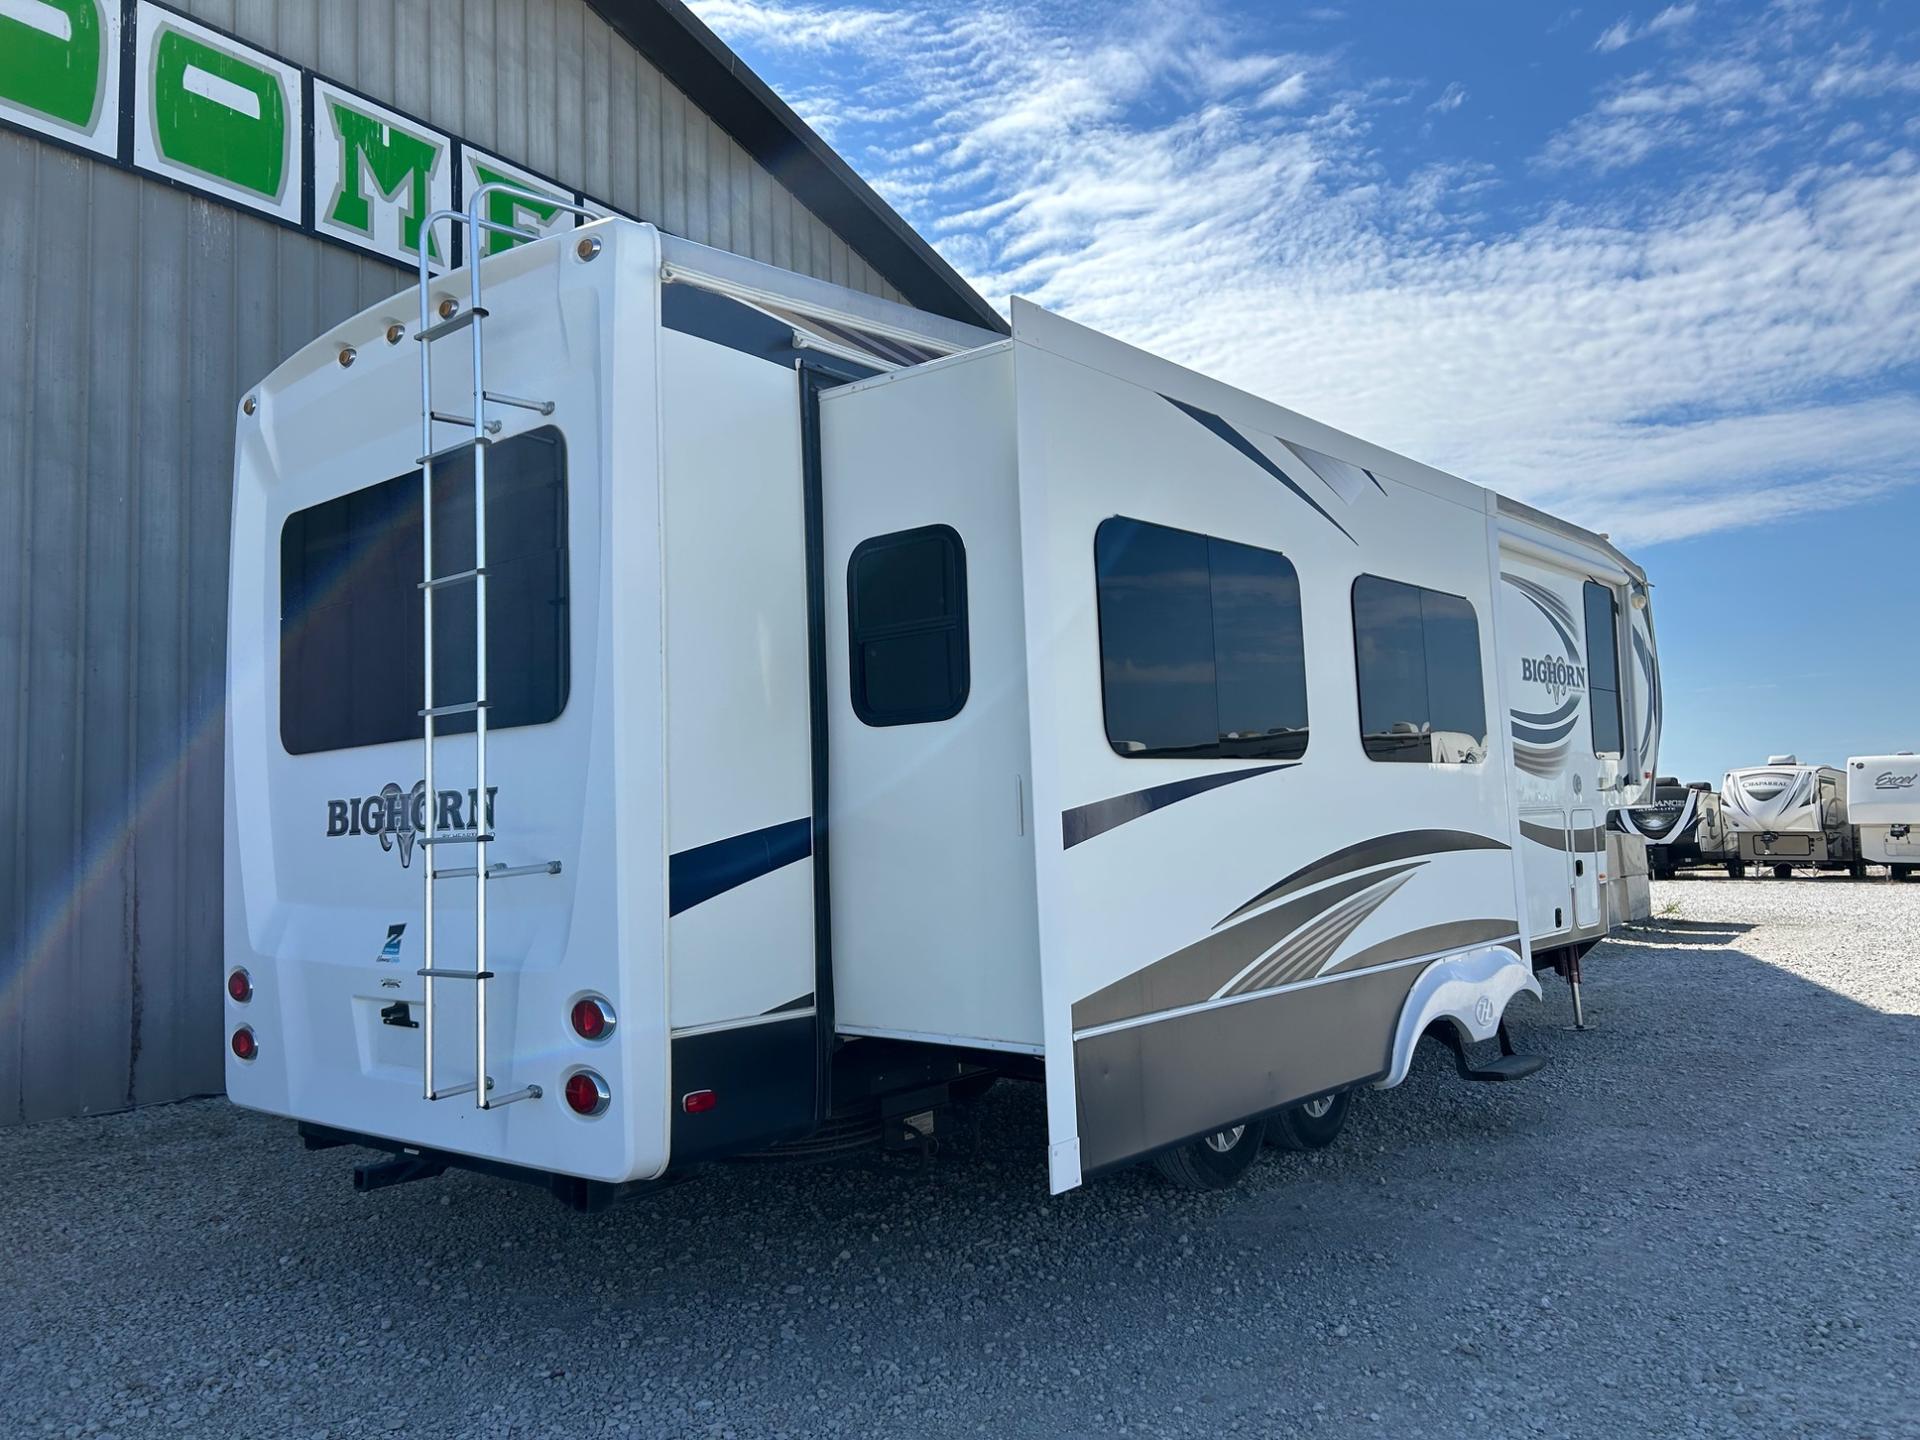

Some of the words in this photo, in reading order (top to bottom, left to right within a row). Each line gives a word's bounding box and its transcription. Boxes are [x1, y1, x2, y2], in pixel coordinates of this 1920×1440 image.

[1521, 657, 1585, 689] BIGHORN
[1875, 771, 1918, 788] Excel
[327, 787, 498, 837] BIGHORN
